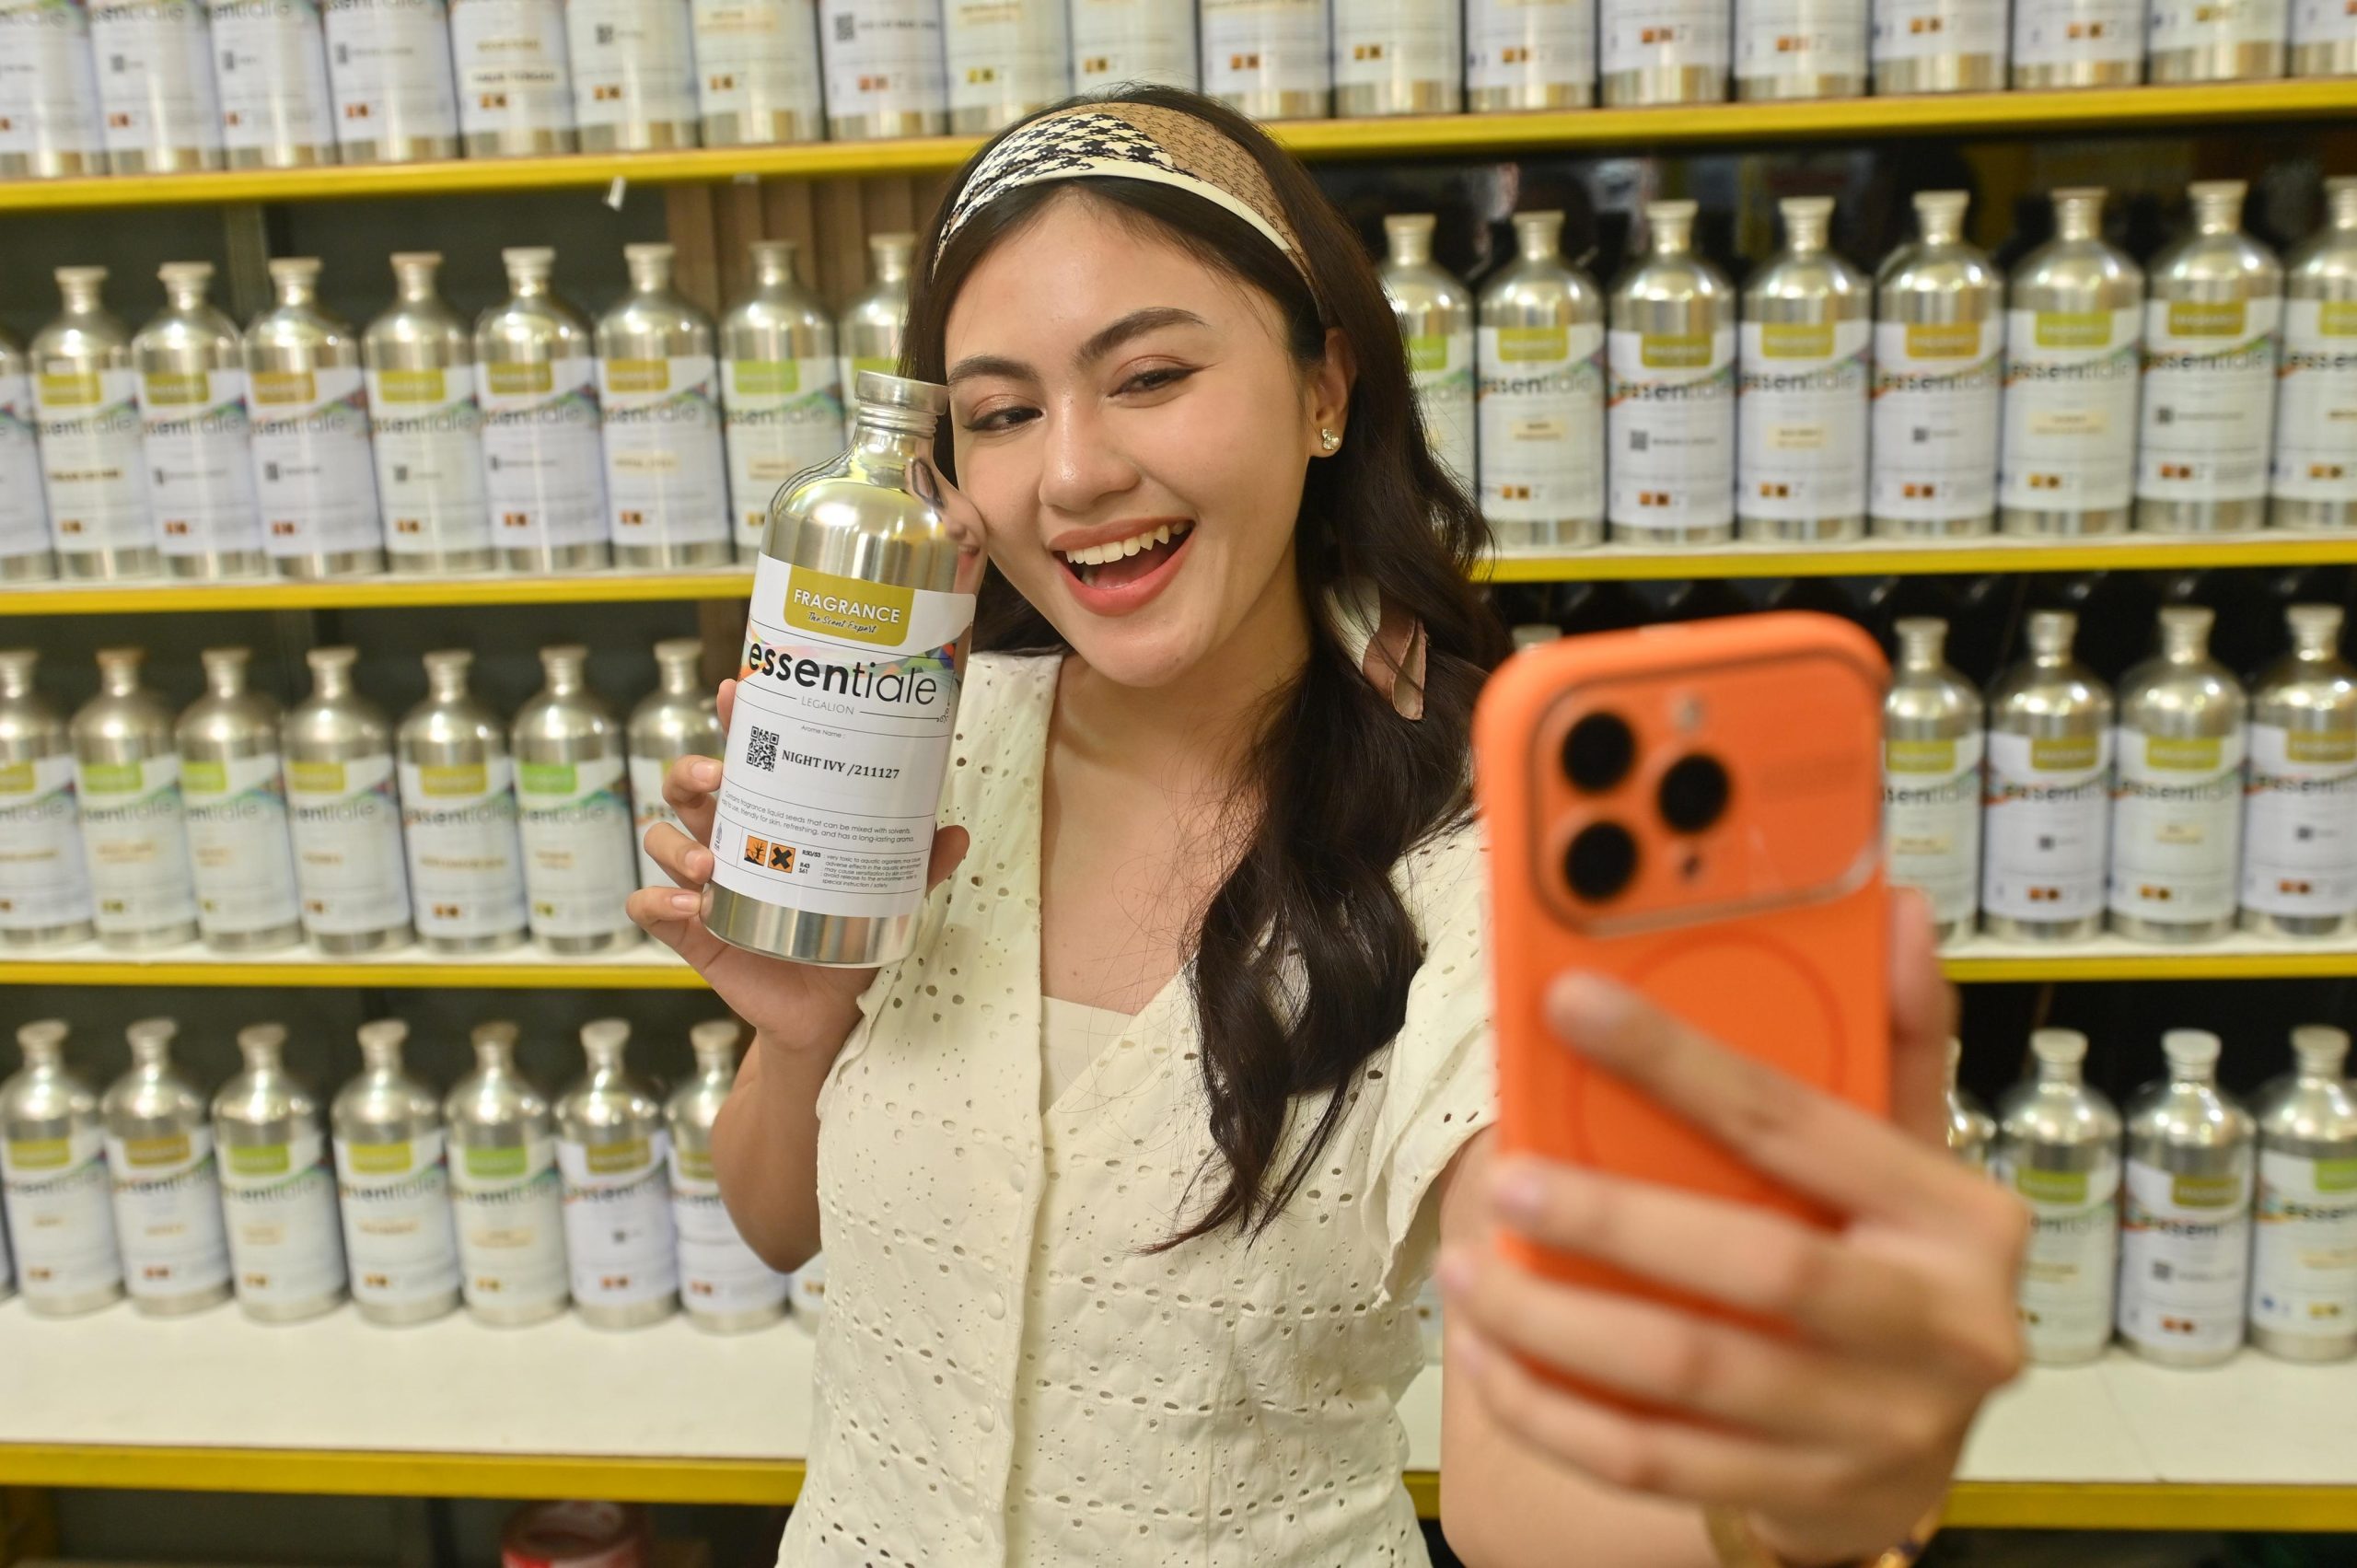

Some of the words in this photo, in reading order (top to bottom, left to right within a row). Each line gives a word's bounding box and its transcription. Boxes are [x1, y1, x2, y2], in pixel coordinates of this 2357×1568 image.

[794, 588, 900, 623] FRAGRANCE
[808, 612, 821, 621] The
[822, 615, 846, 628] Scent
[847, 621, 877, 633] Expert
[749, 643, 937, 705] essentiale
[801, 696, 855, 715] LEGALION
[822, 728, 842, 738] Name
[782, 749, 821, 768] NIGHT
[823, 759, 845, 772] IVY
[847, 763, 900, 779] /211127
[740, 798, 767, 814] fragrance
[767, 807, 784, 819] liquid
[785, 813, 806, 824] seeds
[807, 818, 822, 827] that
[823, 821, 838, 830] can
[840, 823, 850, 831] be
[851, 825, 873, 833] mixed
[740, 808, 759, 820] friendly
[760, 815, 769, 823] for
[821, 830, 836, 838] and
[837, 830, 851, 840] has
[858, 833, 895, 843] long-lasting
